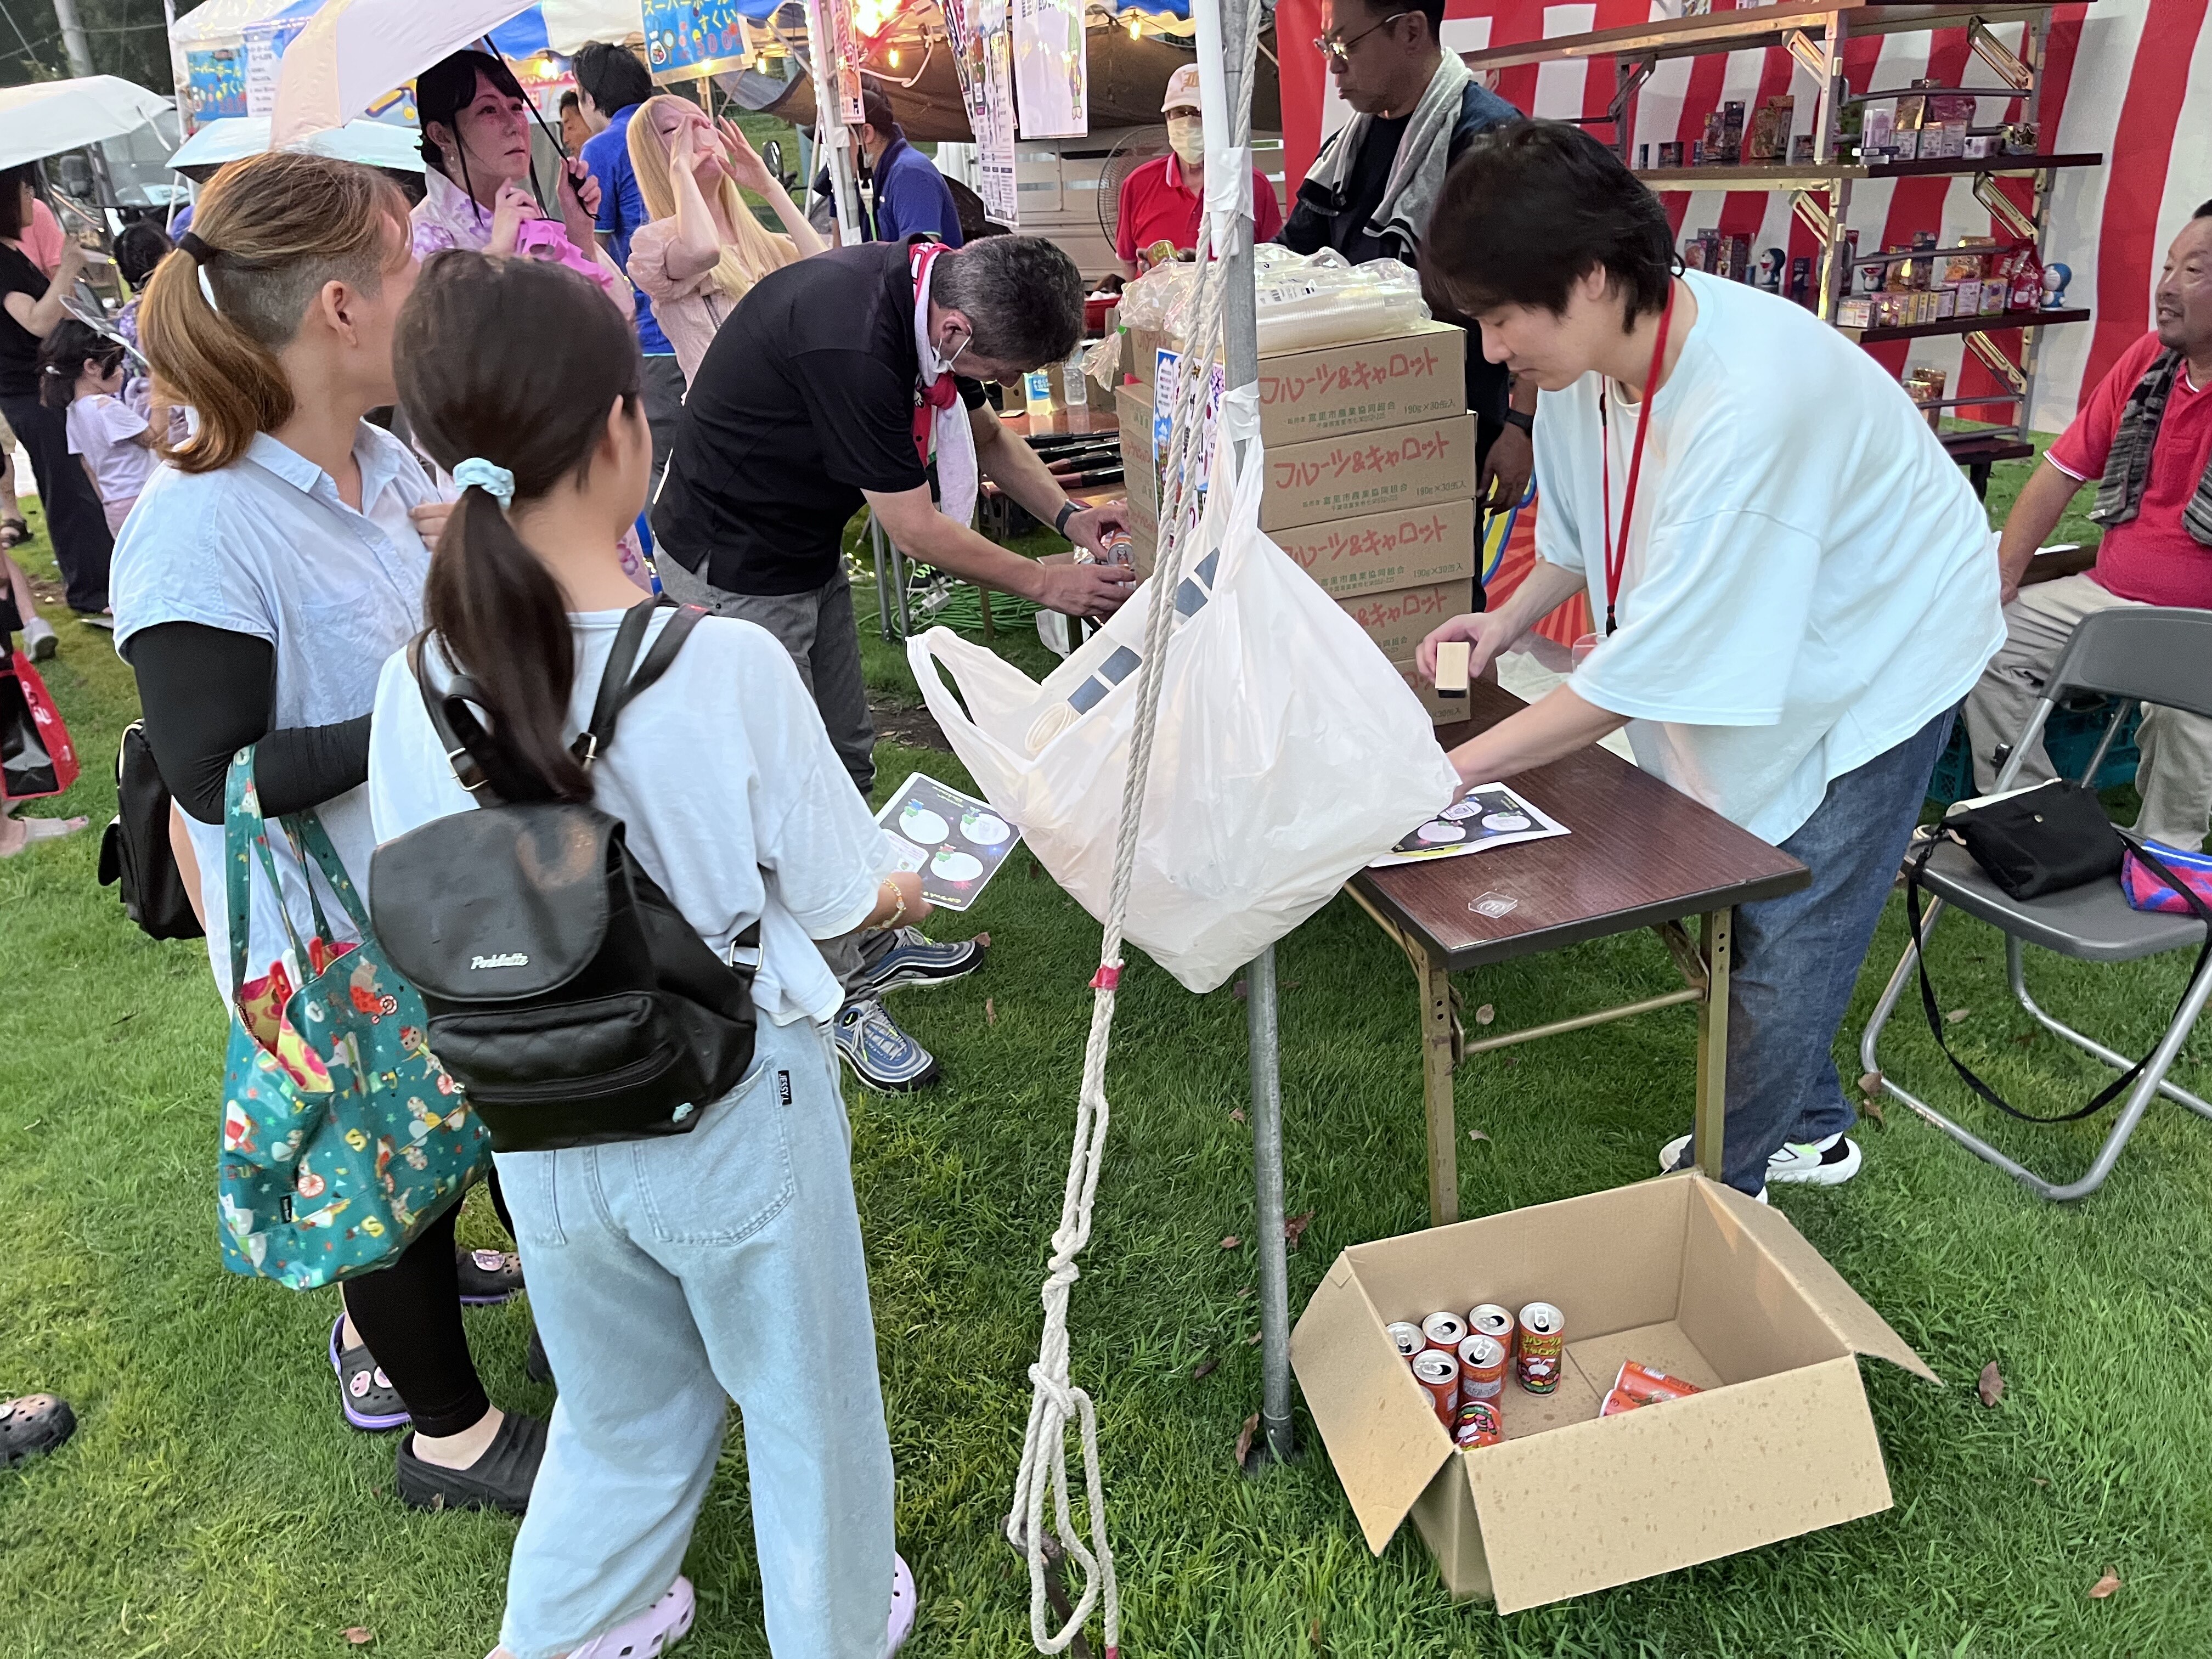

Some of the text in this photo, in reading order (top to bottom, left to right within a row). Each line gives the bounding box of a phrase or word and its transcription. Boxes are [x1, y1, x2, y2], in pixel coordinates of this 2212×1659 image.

[1273, 431, 1450, 489] フルーツ&キャロット
[1353, 587, 1448, 628] &キャロット
